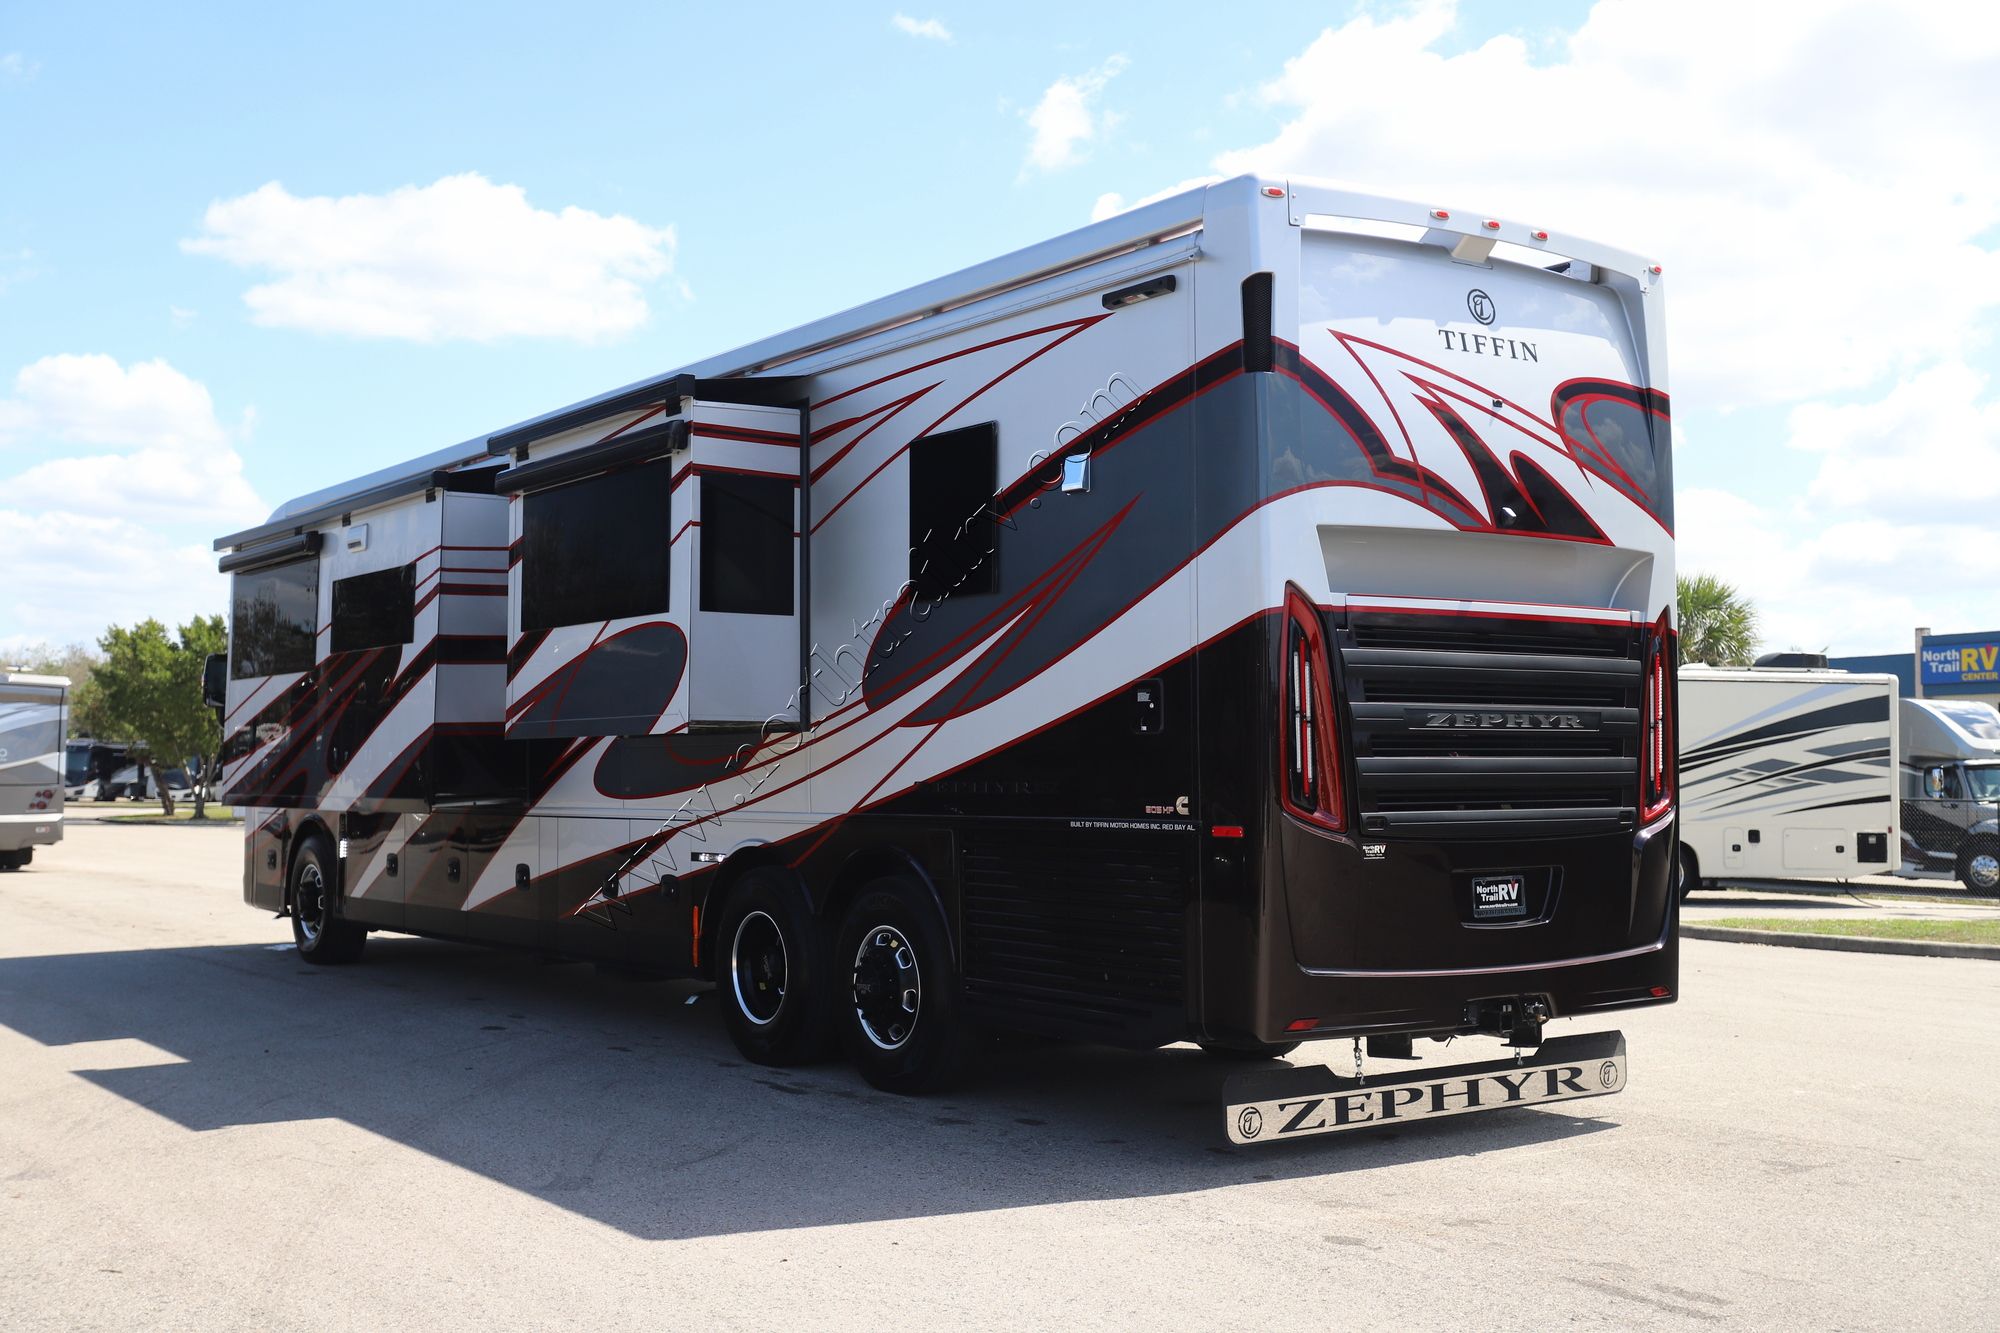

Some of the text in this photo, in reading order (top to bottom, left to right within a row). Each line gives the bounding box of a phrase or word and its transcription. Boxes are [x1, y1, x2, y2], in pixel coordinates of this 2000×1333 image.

[1438, 328, 1539, 363] TIFFIN
[1922, 648, 1960, 662] North
[1960, 645, 1999, 672] RV
[1929, 661, 1960, 673] Trail
[1961, 671, 1999, 681] CENTER
[1426, 712, 1585, 728] ZEPHYR
[1129, 822, 1149, 830] HOMES
[1161, 823, 1174, 831] RED
[1374, 844, 1387, 854] RV
[1476, 884, 1498, 894] North
[1498, 883, 1519, 901] RV
[1480, 893, 1499, 902] Trail
[1277, 1065, 1591, 1134] ZEPHYR
